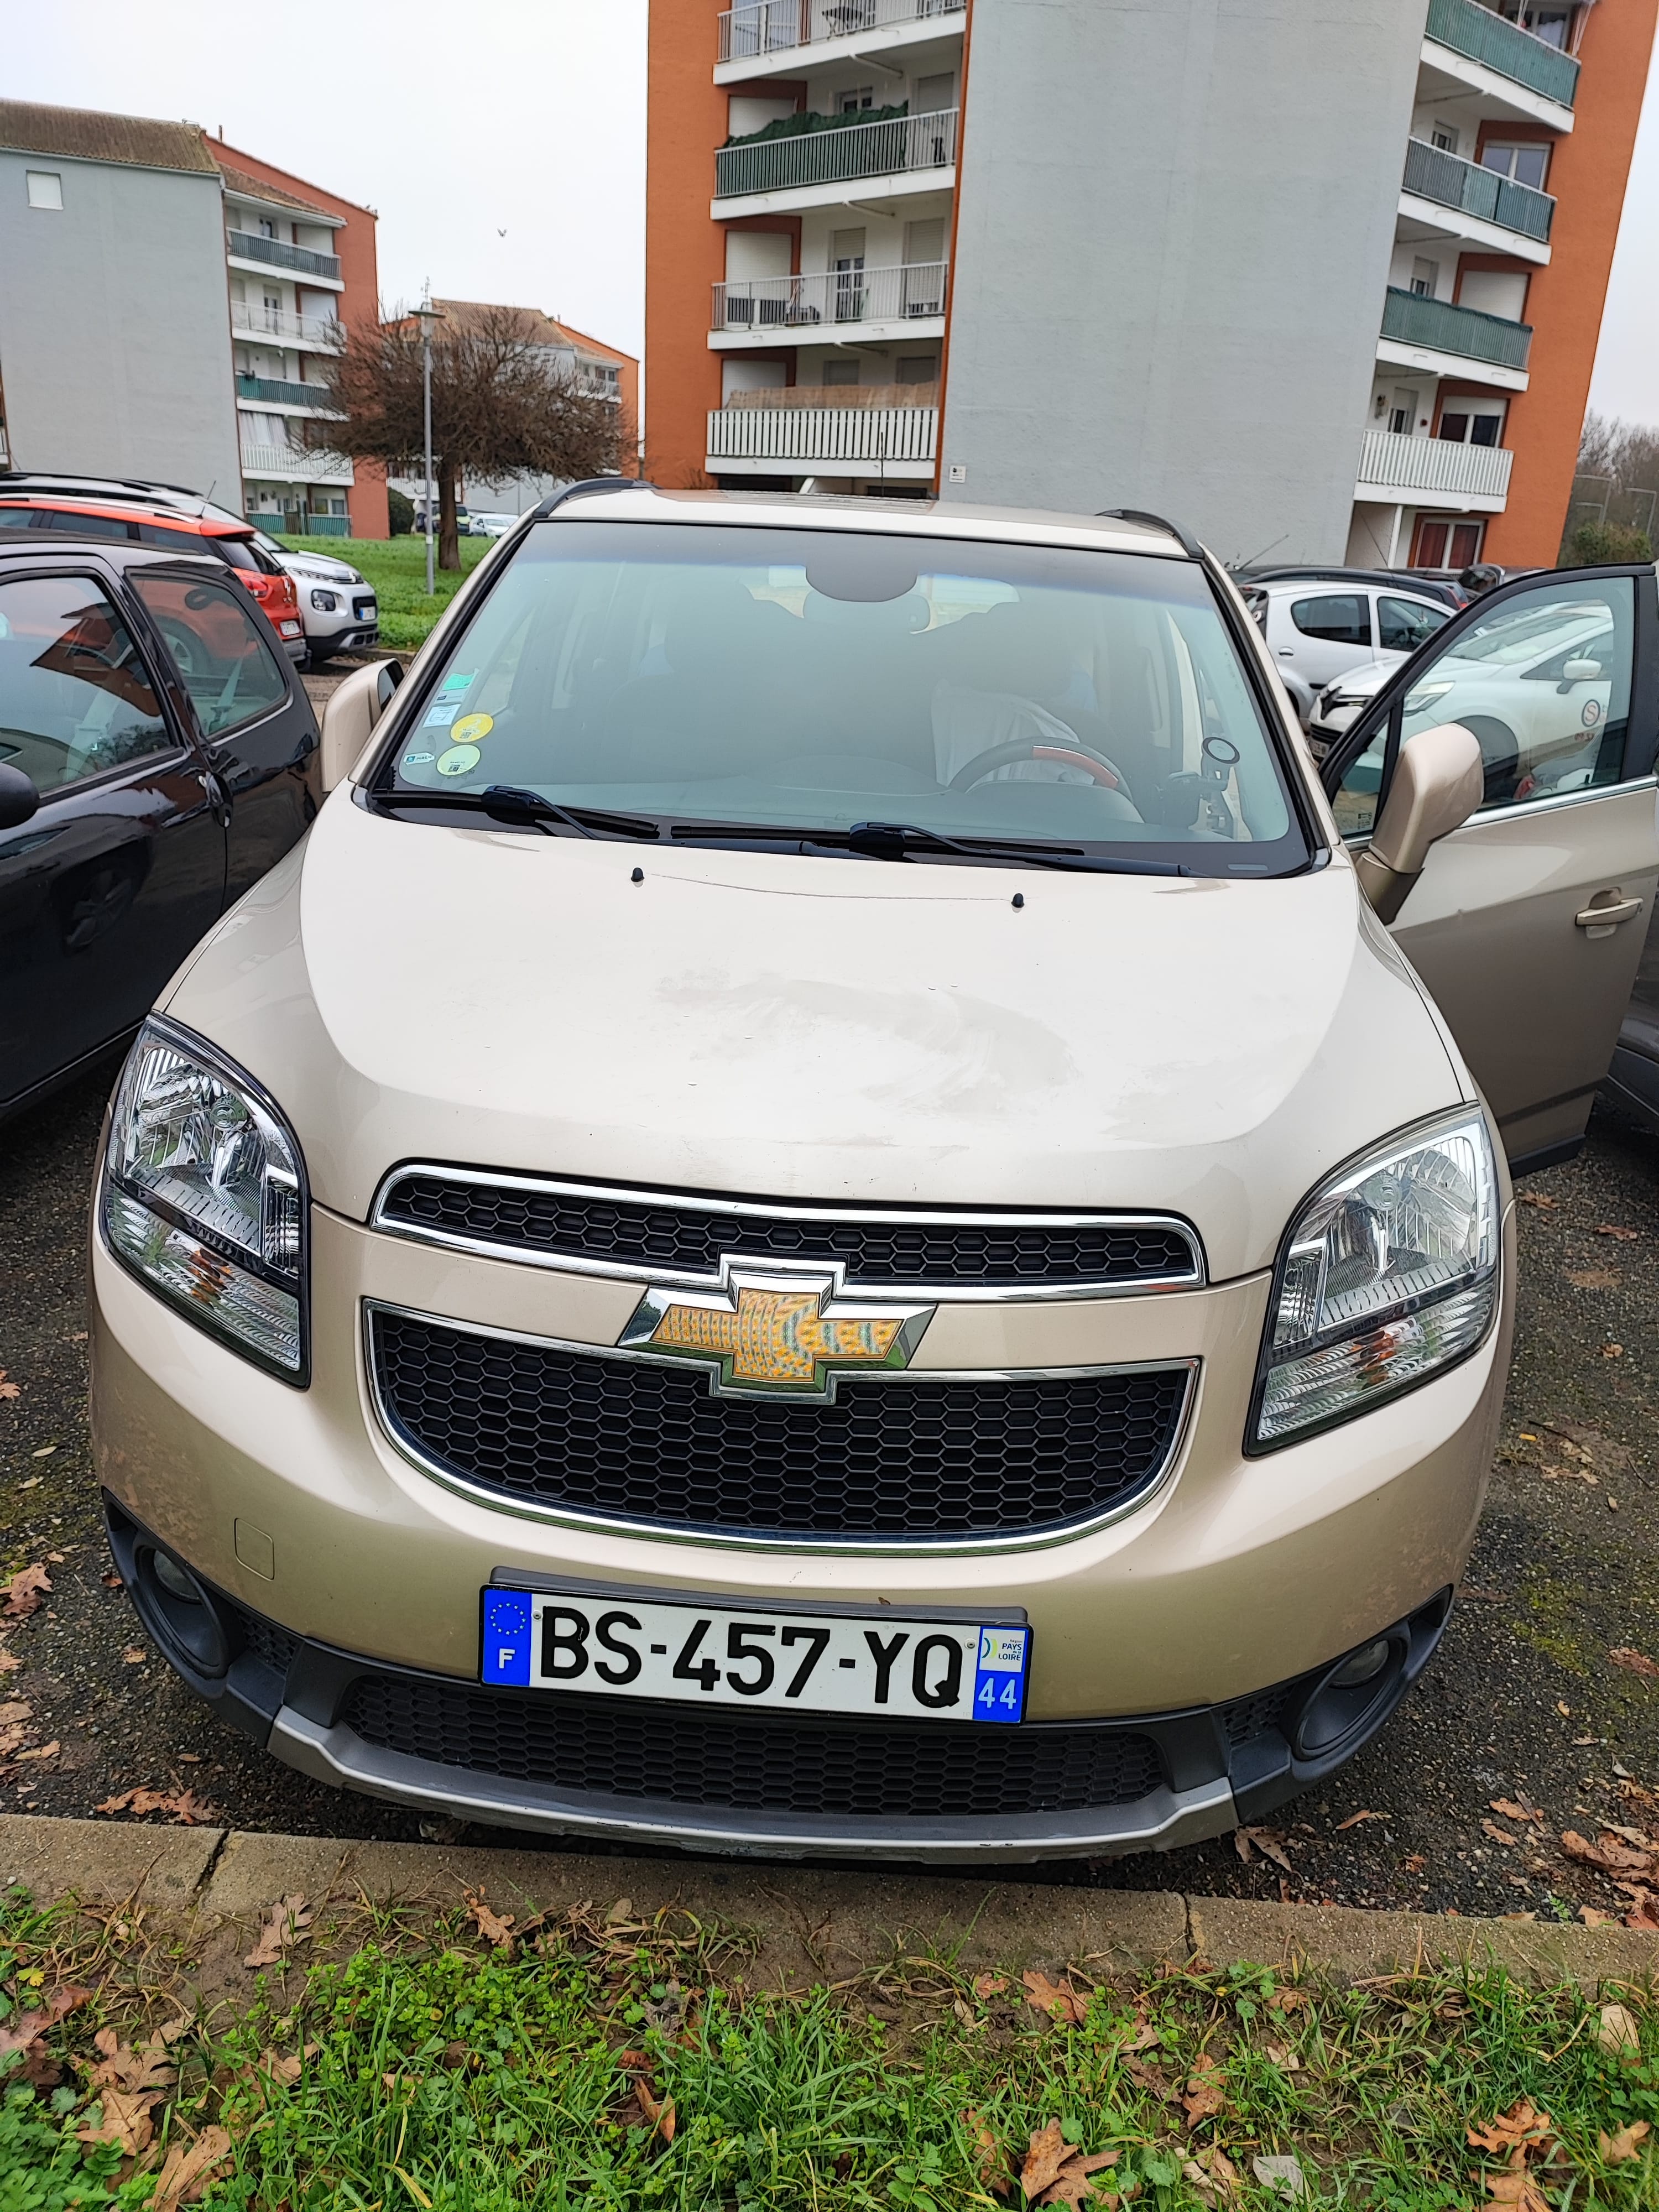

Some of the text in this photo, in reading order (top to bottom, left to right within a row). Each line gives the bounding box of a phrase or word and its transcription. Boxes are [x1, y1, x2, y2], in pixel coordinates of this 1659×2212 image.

[499, 1648, 515, 1669] F
[540, 1605, 963, 1709] BS-457-YQ
[978, 1677, 1016, 1709] 44
